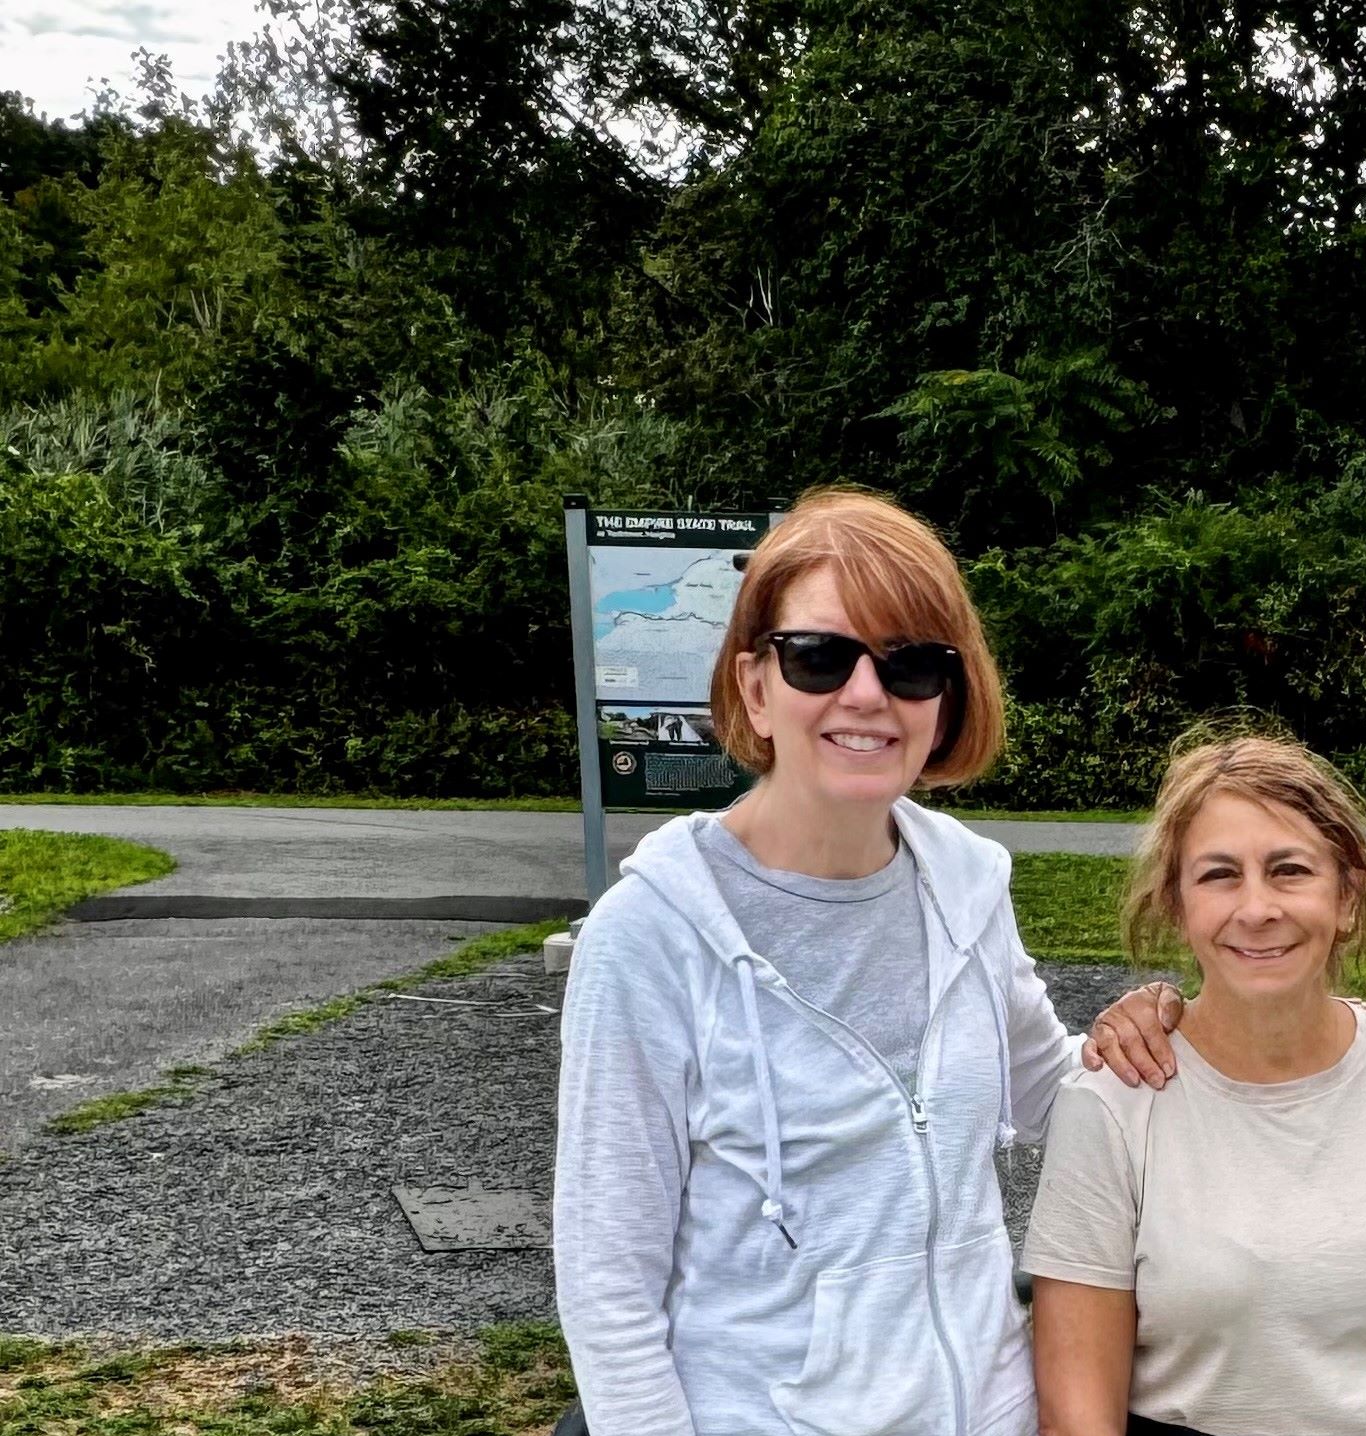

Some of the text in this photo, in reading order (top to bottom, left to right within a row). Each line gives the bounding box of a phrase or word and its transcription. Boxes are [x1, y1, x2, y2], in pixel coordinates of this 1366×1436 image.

[596, 516, 623, 528] THE
[676, 518, 715, 531] STATE
[718, 519, 756, 532] TRAIL
